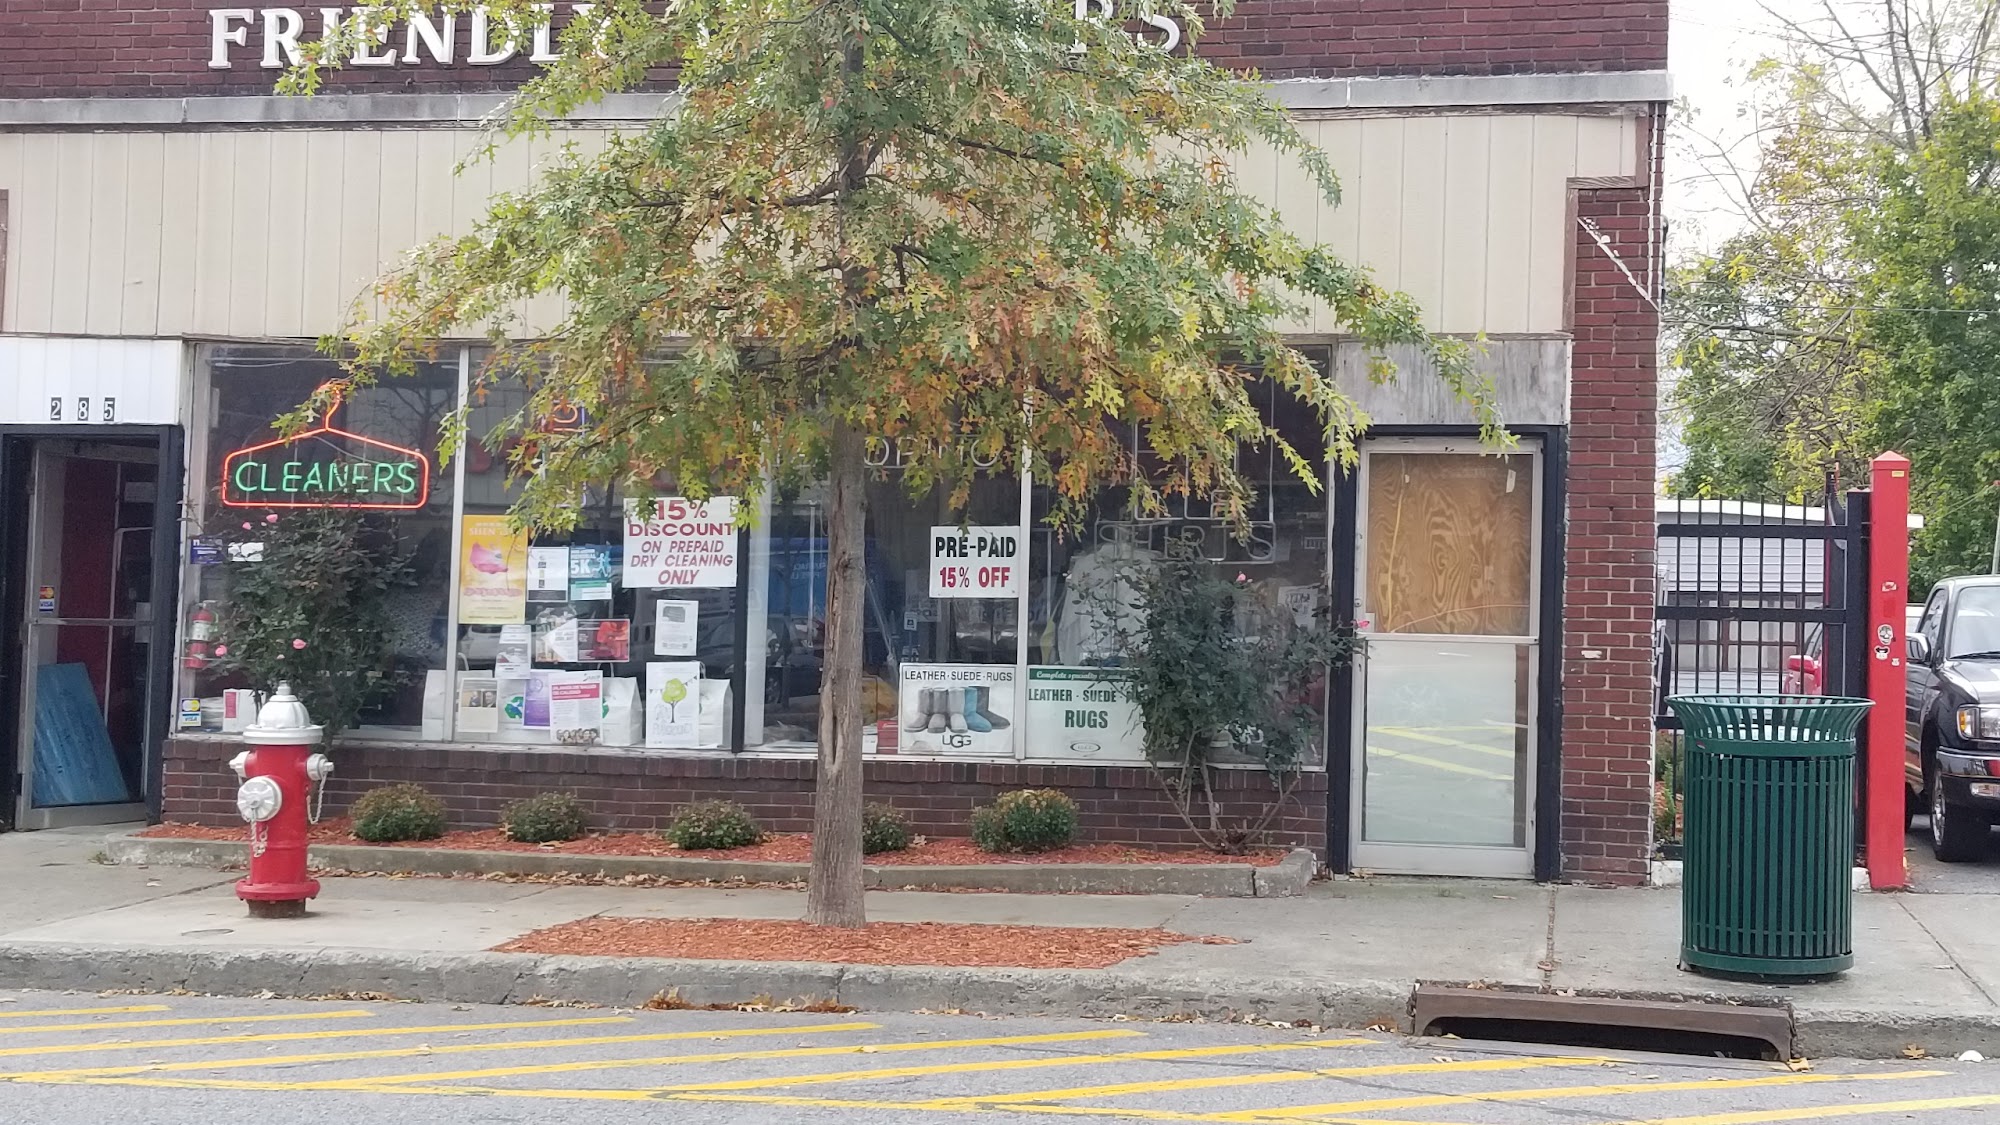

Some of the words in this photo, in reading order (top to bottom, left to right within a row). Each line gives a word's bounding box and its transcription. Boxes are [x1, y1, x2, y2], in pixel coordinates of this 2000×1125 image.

[51, 400, 115, 420] 285
[235, 461, 416, 494] CLEANERS
[655, 499, 708, 520] 15%
[629, 523, 732, 537] DISCOUNT
[641, 541, 662, 553] ON
[669, 540, 724, 553] PREPAID
[935, 536, 1017, 558] PRE-PAID
[571, 560, 591, 574] 5K
[630, 555, 658, 568] DRY
[664, 554, 733, 567] CLEANING
[658, 569, 700, 585] ONLY
[939, 566, 970, 588] 15%
[978, 566, 1011, 588] OFF
[904, 670, 946, 680] LEATHER
[951, 671, 983, 681] SUEDE
[987, 672, 1013, 681] RUGS
[1036, 671, 1067, 680] Complete
[1028, 689, 1072, 702] LEATHER
[1083, 690, 1117, 702] SUEDE
[1065, 710, 1109, 728] RUGS
[942, 735, 972, 748] UGG
